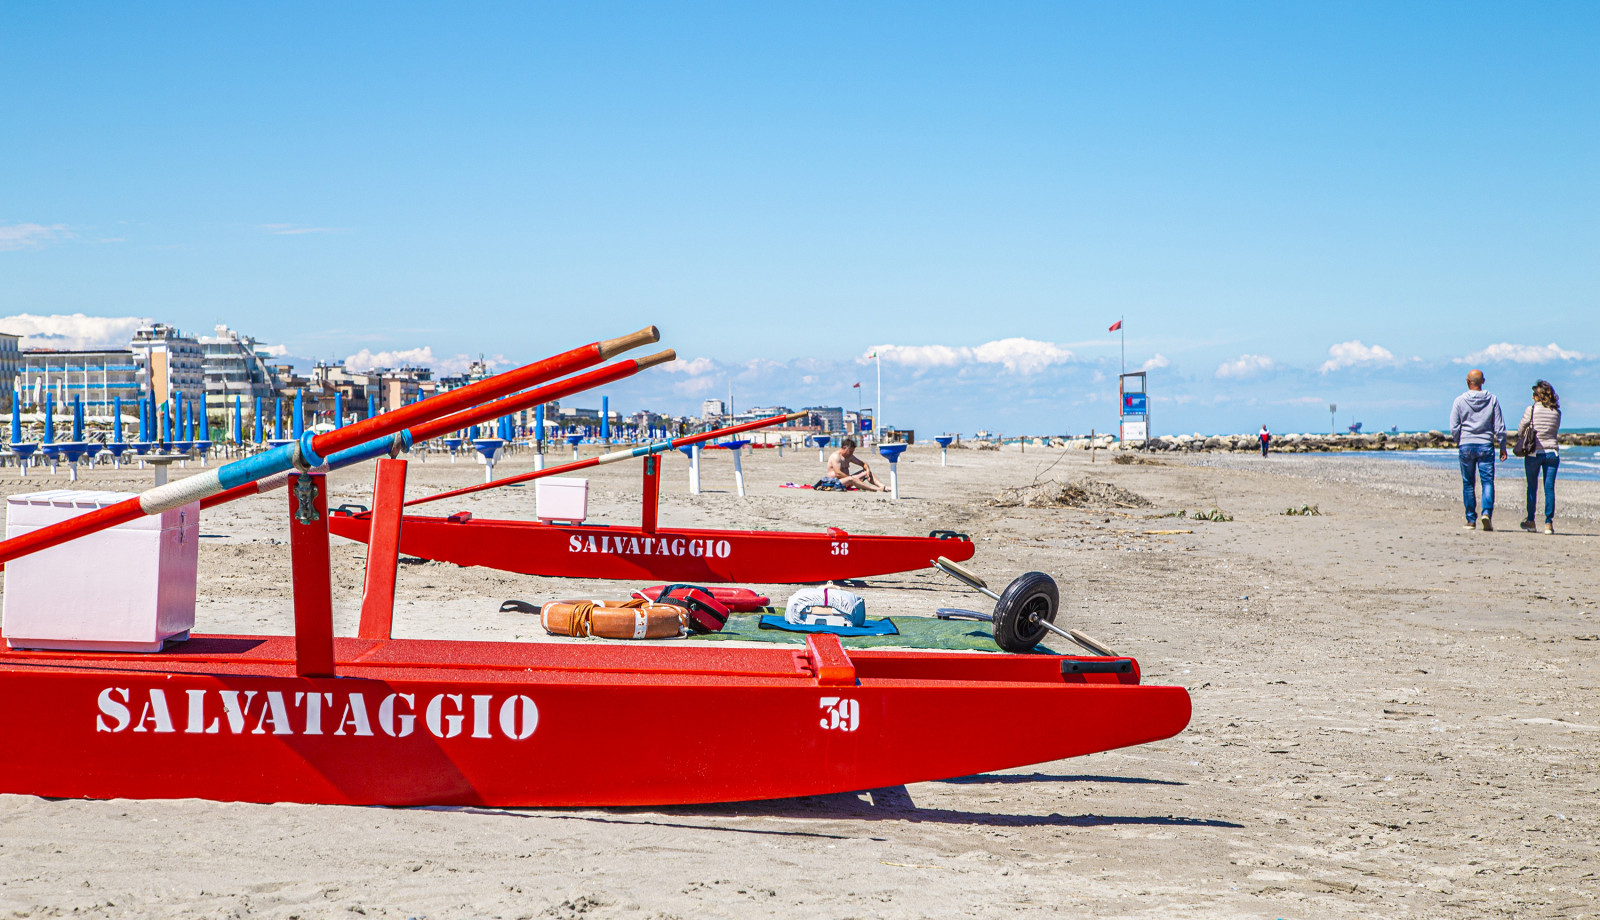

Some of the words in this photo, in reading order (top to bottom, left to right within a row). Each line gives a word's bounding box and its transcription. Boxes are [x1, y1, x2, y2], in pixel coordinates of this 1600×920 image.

[568, 535, 732, 558] SALVATAGGIO
[830, 541, 849, 556] 38
[96, 687, 539, 741] SALVATAGGIO
[819, 697, 860, 732] 39
